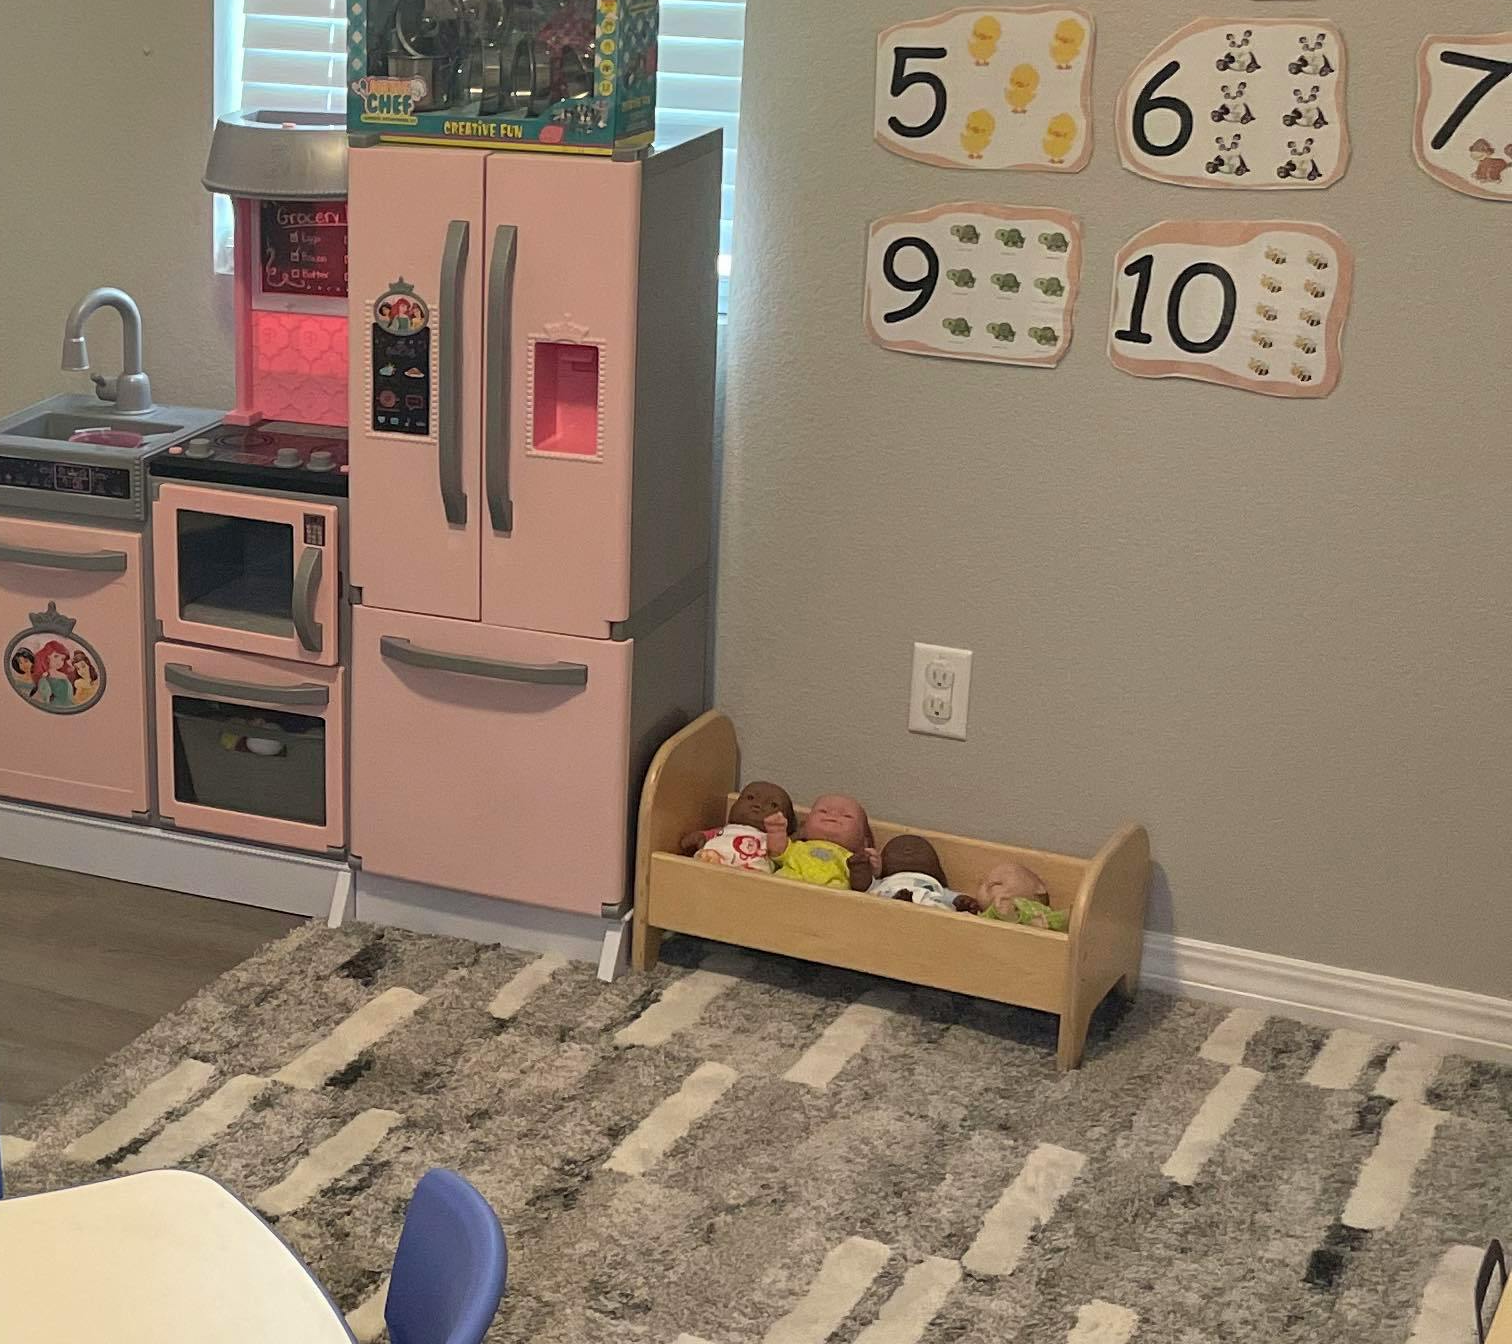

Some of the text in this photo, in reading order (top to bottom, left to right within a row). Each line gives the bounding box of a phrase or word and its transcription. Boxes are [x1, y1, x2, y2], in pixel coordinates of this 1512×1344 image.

[500, 123, 524, 139] FUN
[887, 46, 948, 138] 5
[1132, 60, 1194, 157] 6
[1430, 50, 1512, 150] 7
[882, 236, 940, 324] 9
[1115, 254, 1237, 354] 10
